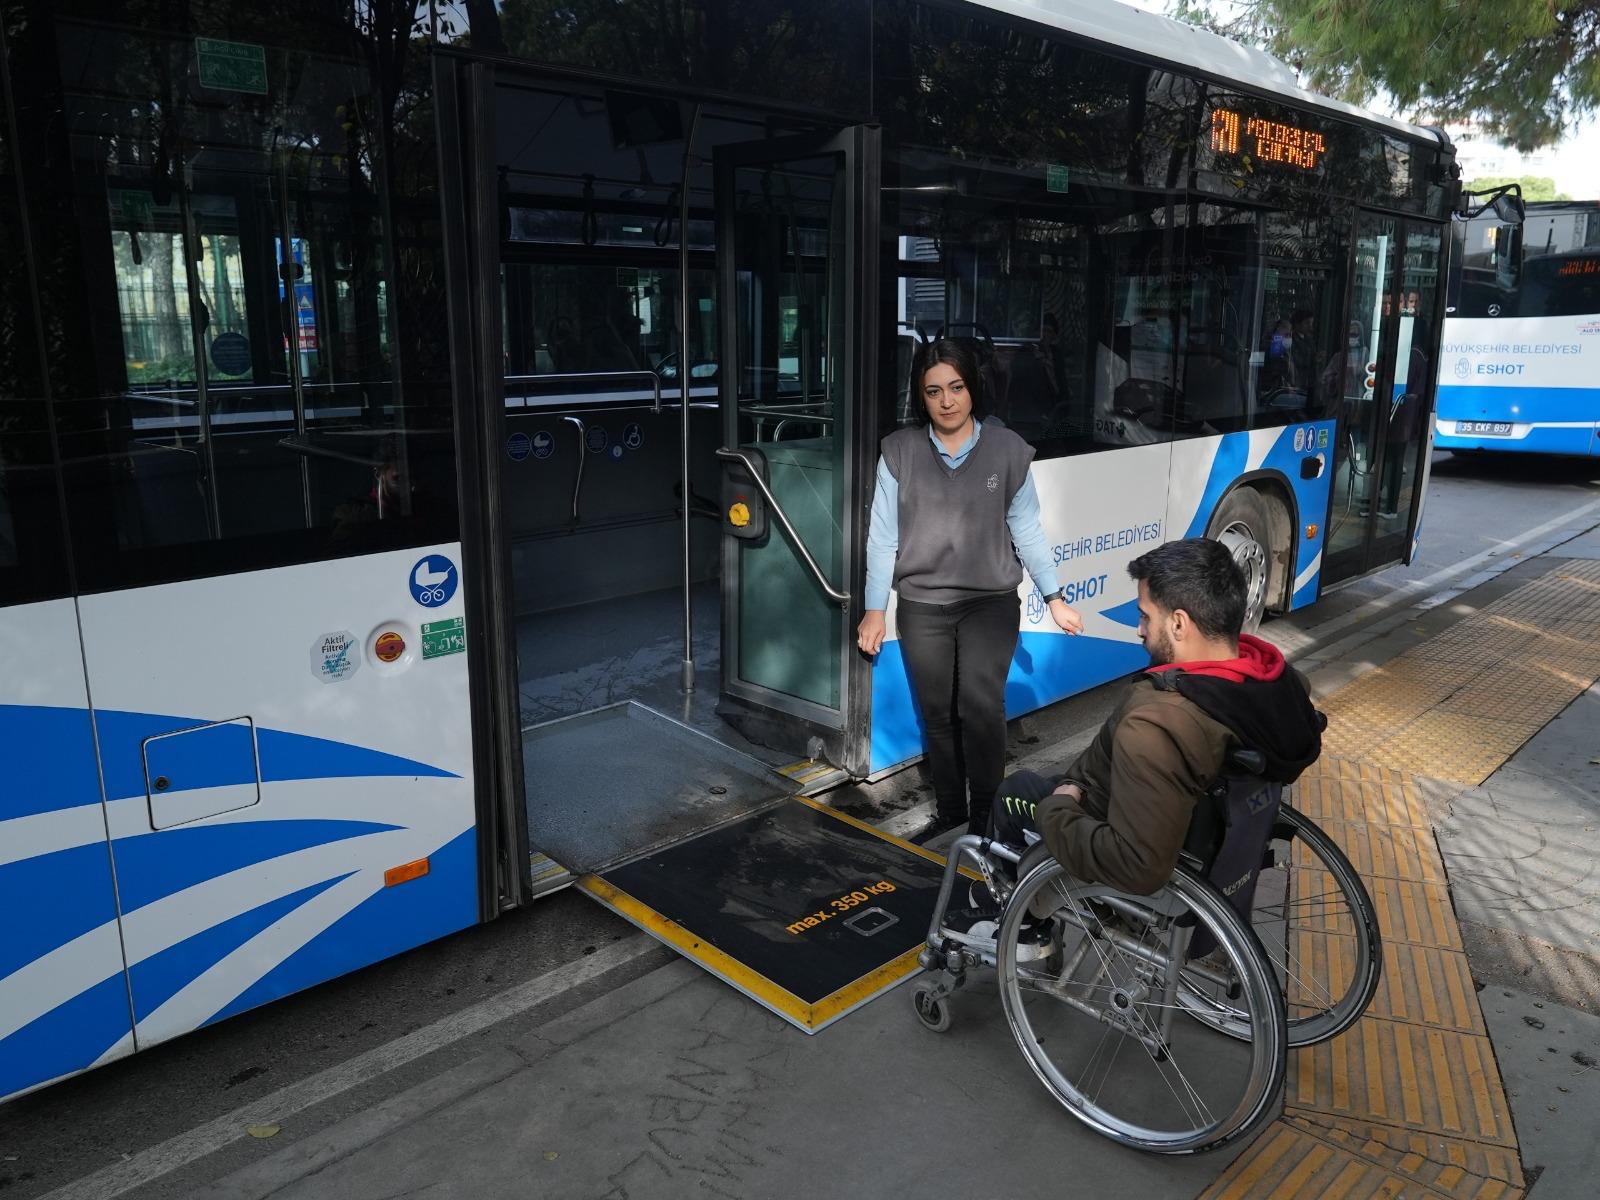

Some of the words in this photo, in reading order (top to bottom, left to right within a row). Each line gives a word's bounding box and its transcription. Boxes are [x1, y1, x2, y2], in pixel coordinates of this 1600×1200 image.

[1513, 343, 1582, 354] BELEDİYESİ
[1477, 364, 1525, 375] ESHOT
[1461, 422, 1472, 431] 35
[1475, 423, 1491, 432] CKF
[1050, 536, 1092, 567] ŞEHİR
[1095, 519, 1161, 553] BELEDİYESİ
[325, 635, 344, 645] Aktif
[321, 642, 349, 653] Filtreli
[785, 910, 837, 935] max.
[831, 891, 868, 911] 350
[864, 880, 896, 896] kg
